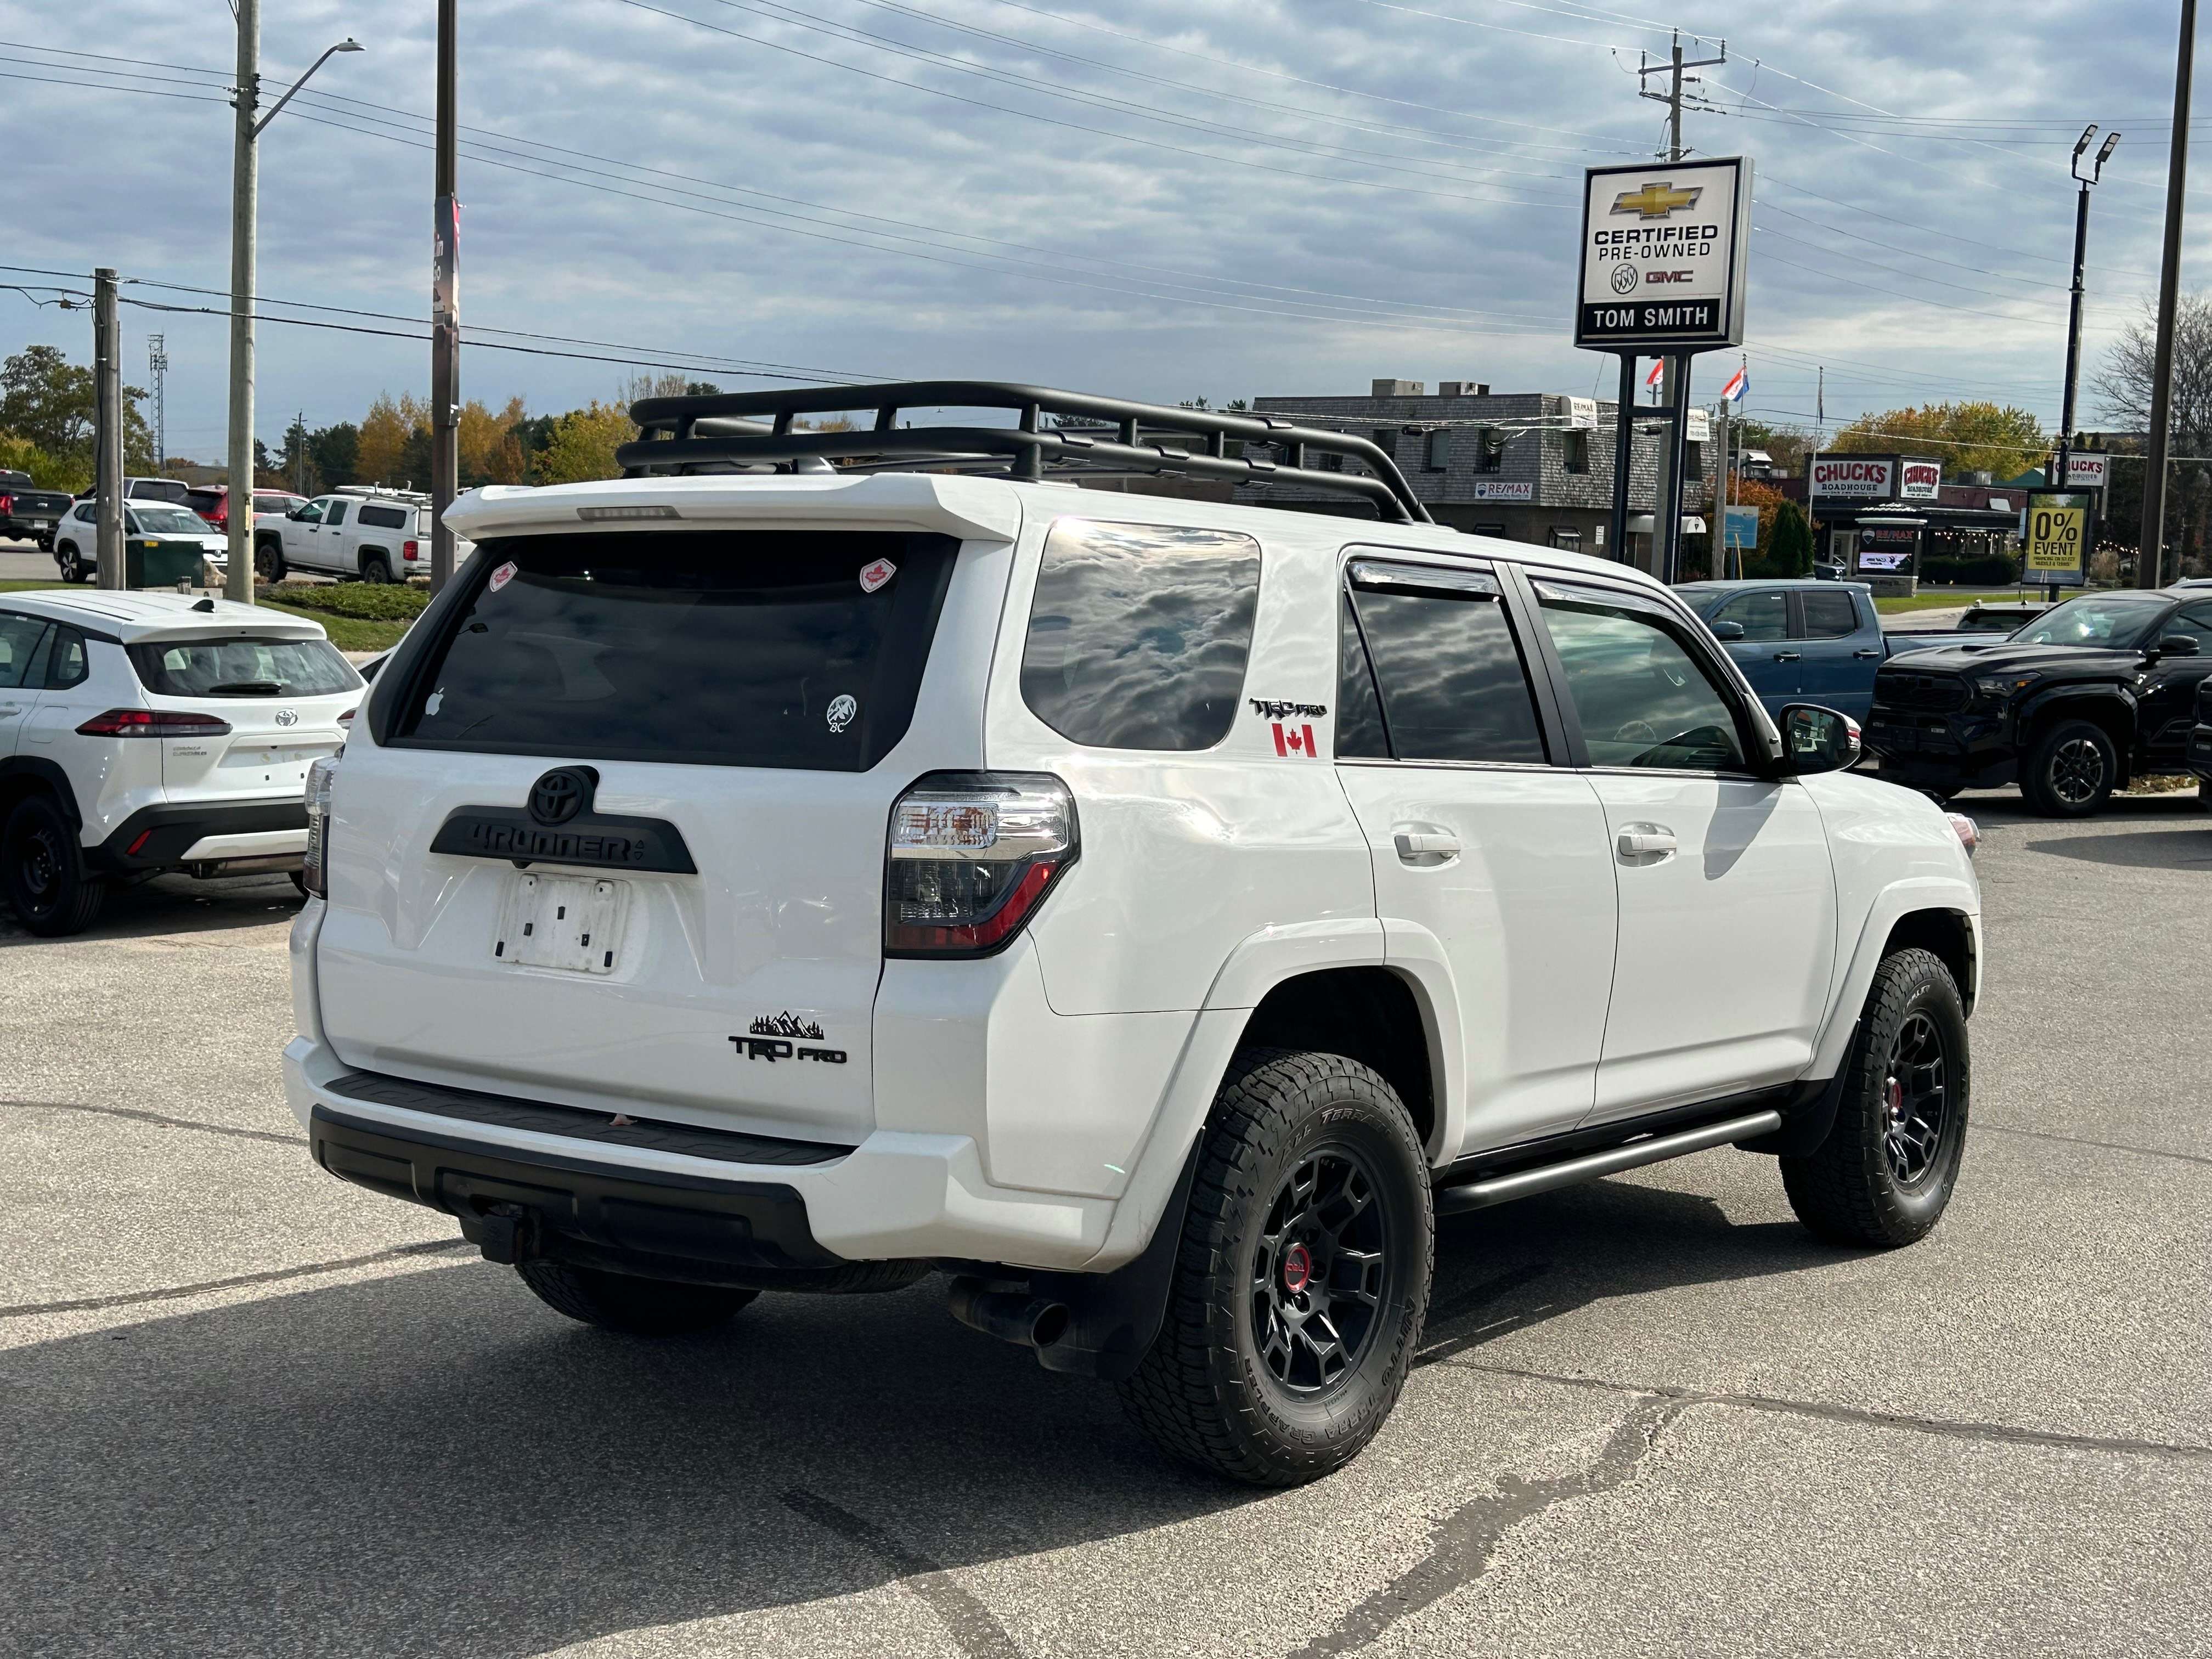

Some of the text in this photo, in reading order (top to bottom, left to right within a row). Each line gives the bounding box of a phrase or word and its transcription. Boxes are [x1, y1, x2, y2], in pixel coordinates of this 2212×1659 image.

[1594, 225, 1718, 245] CERTIFIED
[1599, 242, 1711, 261] PRE-OWNED
[1645, 270, 1694, 284] GMC
[1594, 306, 1708, 328] TOM SMITH
[1815, 462, 1887, 484] CHUCK'S
[1488, 484, 1530, 494] RE/MAX
[1821, 483, 1878, 492] ROADHOUSE
[2035, 512, 2078, 541] 0%
[2034, 541, 2075, 556] EVENT
[829, 722, 845, 733] BC
[469, 823, 630, 861] 4RUNNER
[729, 1036, 847, 1064] TRD PRO
